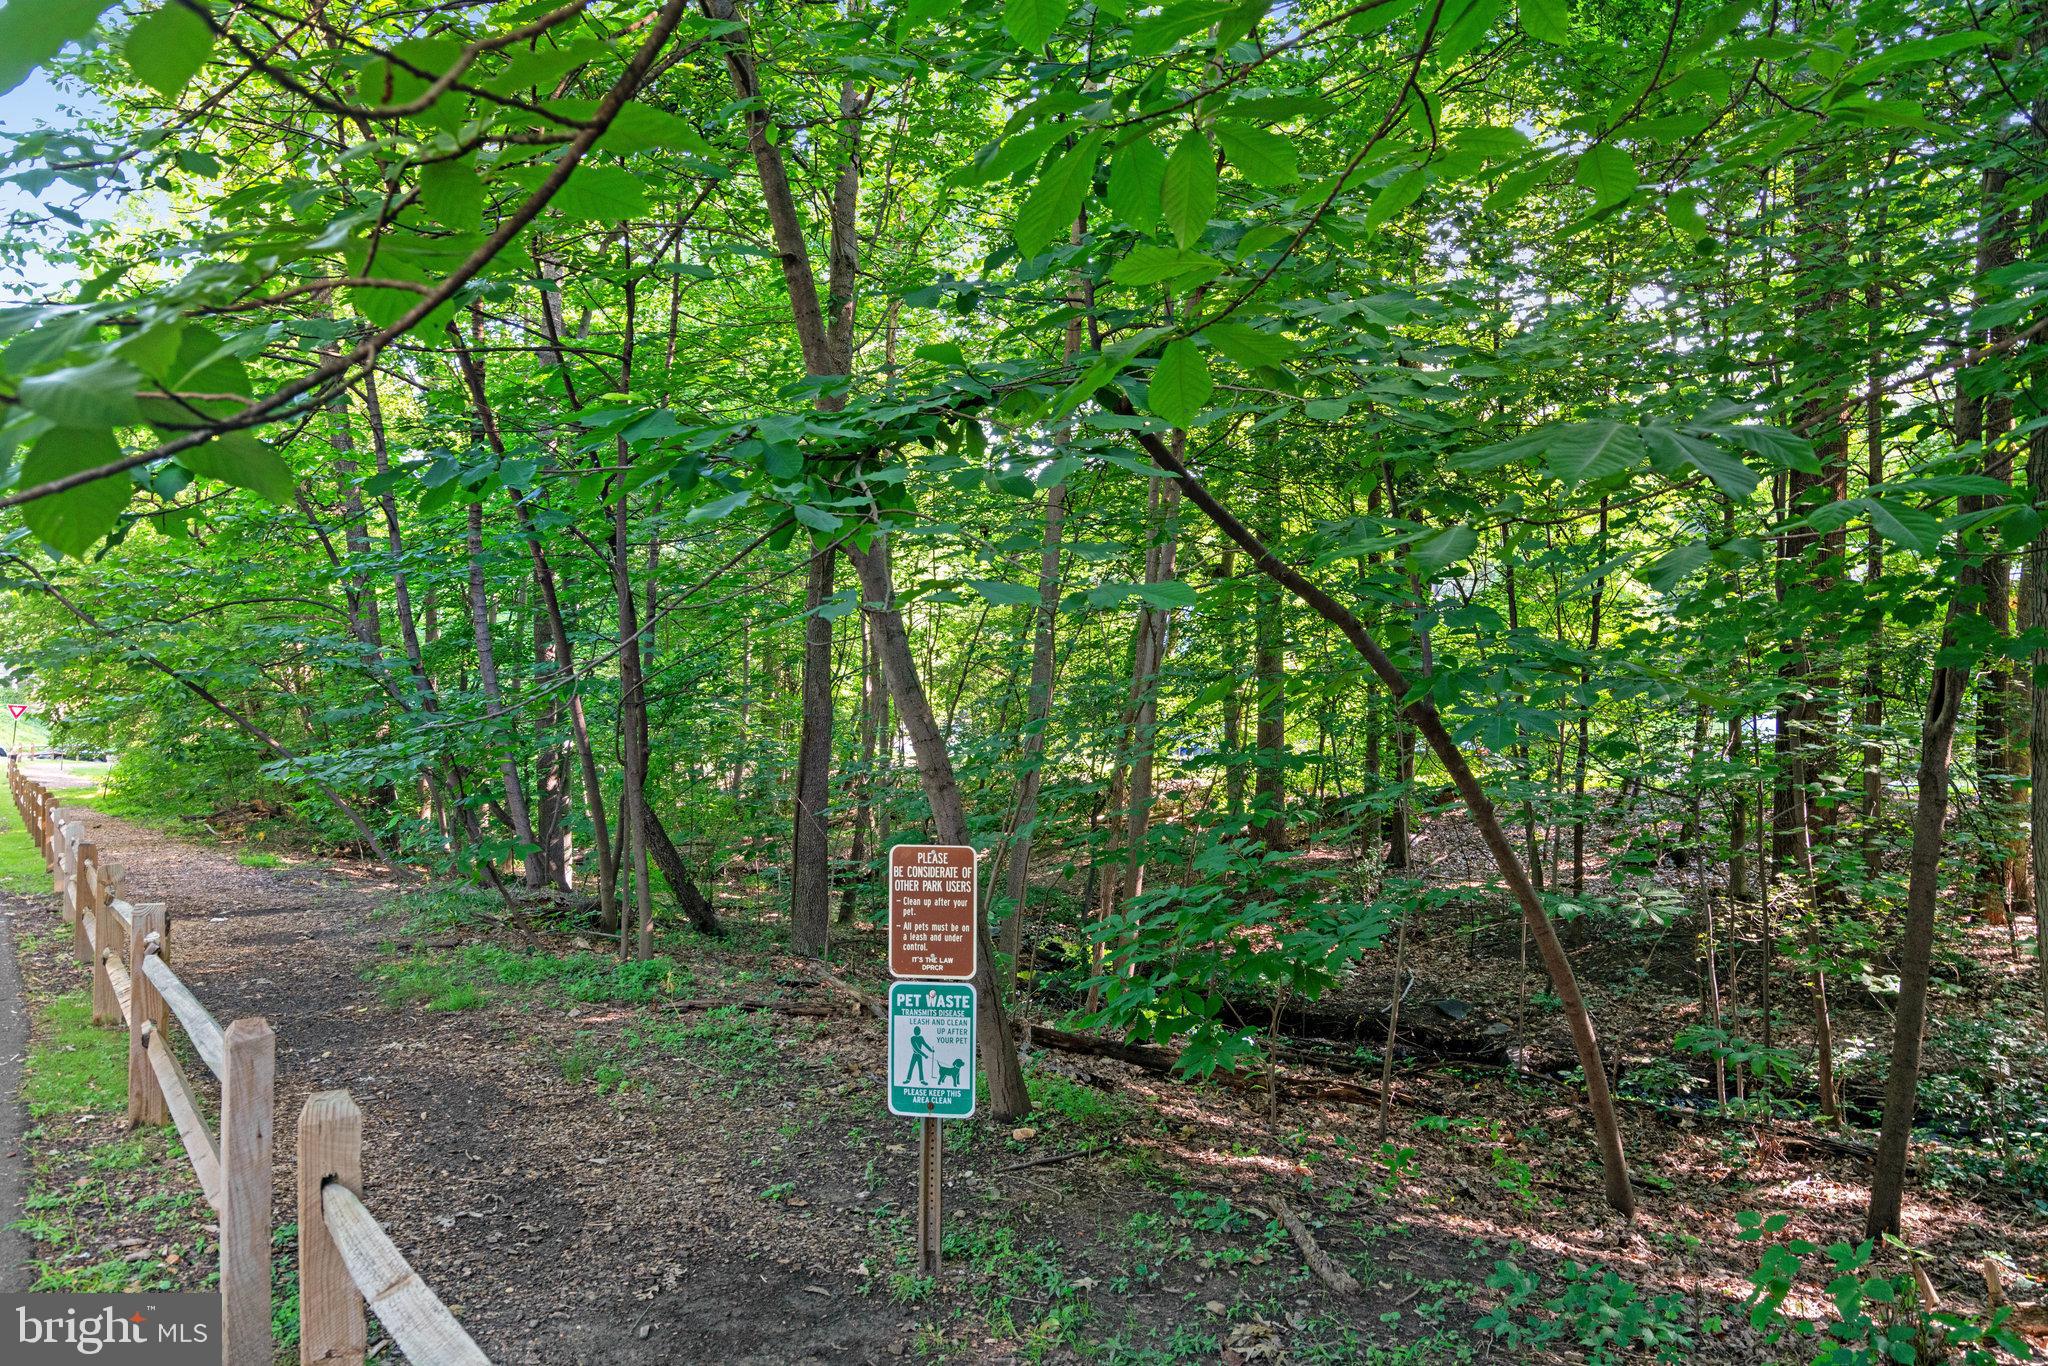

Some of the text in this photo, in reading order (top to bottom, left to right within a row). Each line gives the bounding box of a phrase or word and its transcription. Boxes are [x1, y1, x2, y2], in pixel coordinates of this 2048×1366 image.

[918, 852, 948, 864] PLEASE
[894, 866, 972, 878] BE CONSIDERATE OF
[895, 880, 971, 892] OTHER PARK USERS
[903, 897, 921, 906] Clean
[924, 899, 931, 908] up
[935, 898, 950, 906] after
[953, 899, 968, 908] your
[903, 908, 916, 917] pet.
[903, 922, 912, 930] All
[915, 922, 929, 932] pets
[932, 923, 948, 931] must
[951, 924, 959, 932] be
[962, 924, 970, 932] on
[910, 933, 927, 941] leash
[930, 933, 942, 941] and
[945, 934, 963, 942] under
[903, 943, 928, 951] control.
[897, 994, 970, 1008] PET WASTE
[903, 1088, 927, 1096] PLEASE
